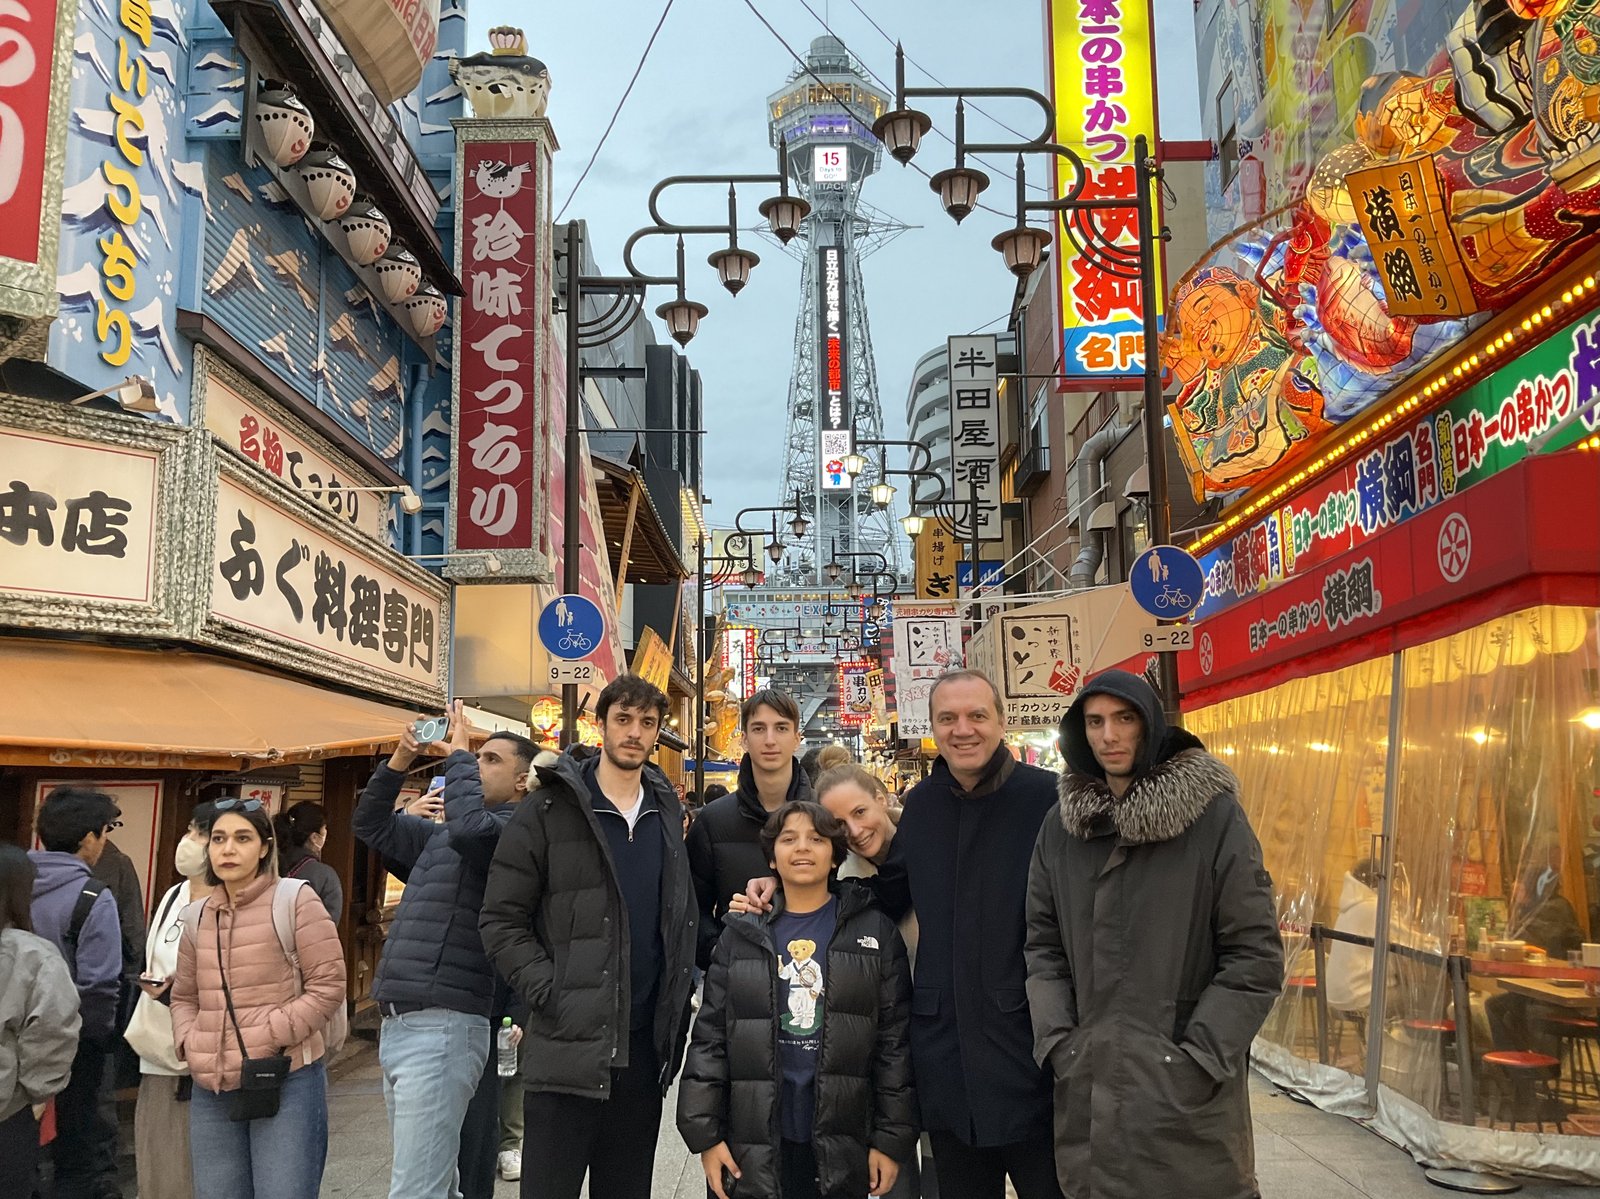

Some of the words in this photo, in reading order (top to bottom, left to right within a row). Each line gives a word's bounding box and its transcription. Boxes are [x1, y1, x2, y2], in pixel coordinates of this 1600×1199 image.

[823, 152, 839, 165] 15
[1362, 185, 1422, 302] 横綱
[1399, 172, 1447, 310] 日本一の串かつ
[1454, 373, 1571, 473] 日本一の串かつ
[1357, 434, 1417, 534] 横綱
[932, 528, 945, 566] 串揚げ
[1250, 602, 1320, 651] 日本一の串かつ
[1323, 560, 1373, 629] 横綱
[1008, 703, 1017, 712] 1F
[1020, 702, 1070, 712] カウンター
[1008, 716, 1018, 725] 2F
